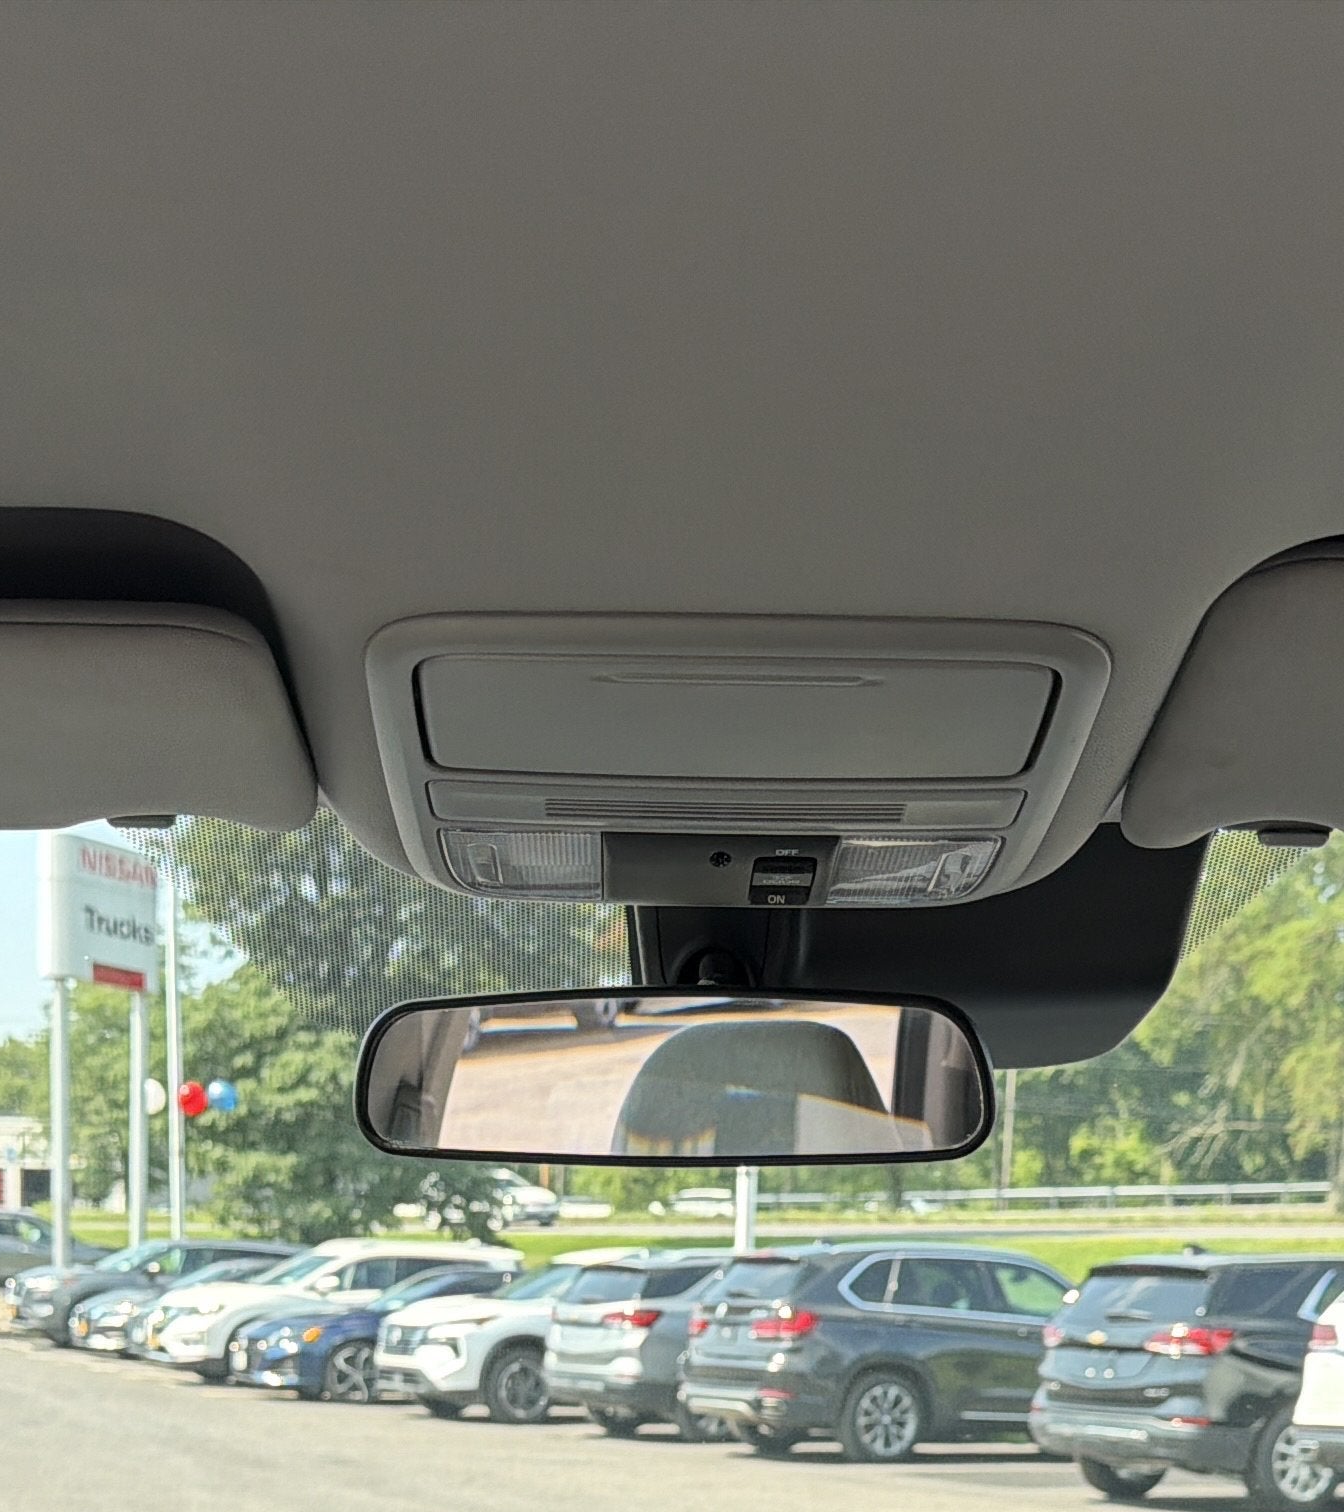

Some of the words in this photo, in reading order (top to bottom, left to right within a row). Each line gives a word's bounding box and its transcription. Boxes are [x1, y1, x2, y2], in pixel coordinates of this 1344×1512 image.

[776, 849, 800, 857] OFF
[80, 847, 157, 889] NISSAN
[767, 895, 786, 904] ON
[85, 904, 155, 946] Trucks
